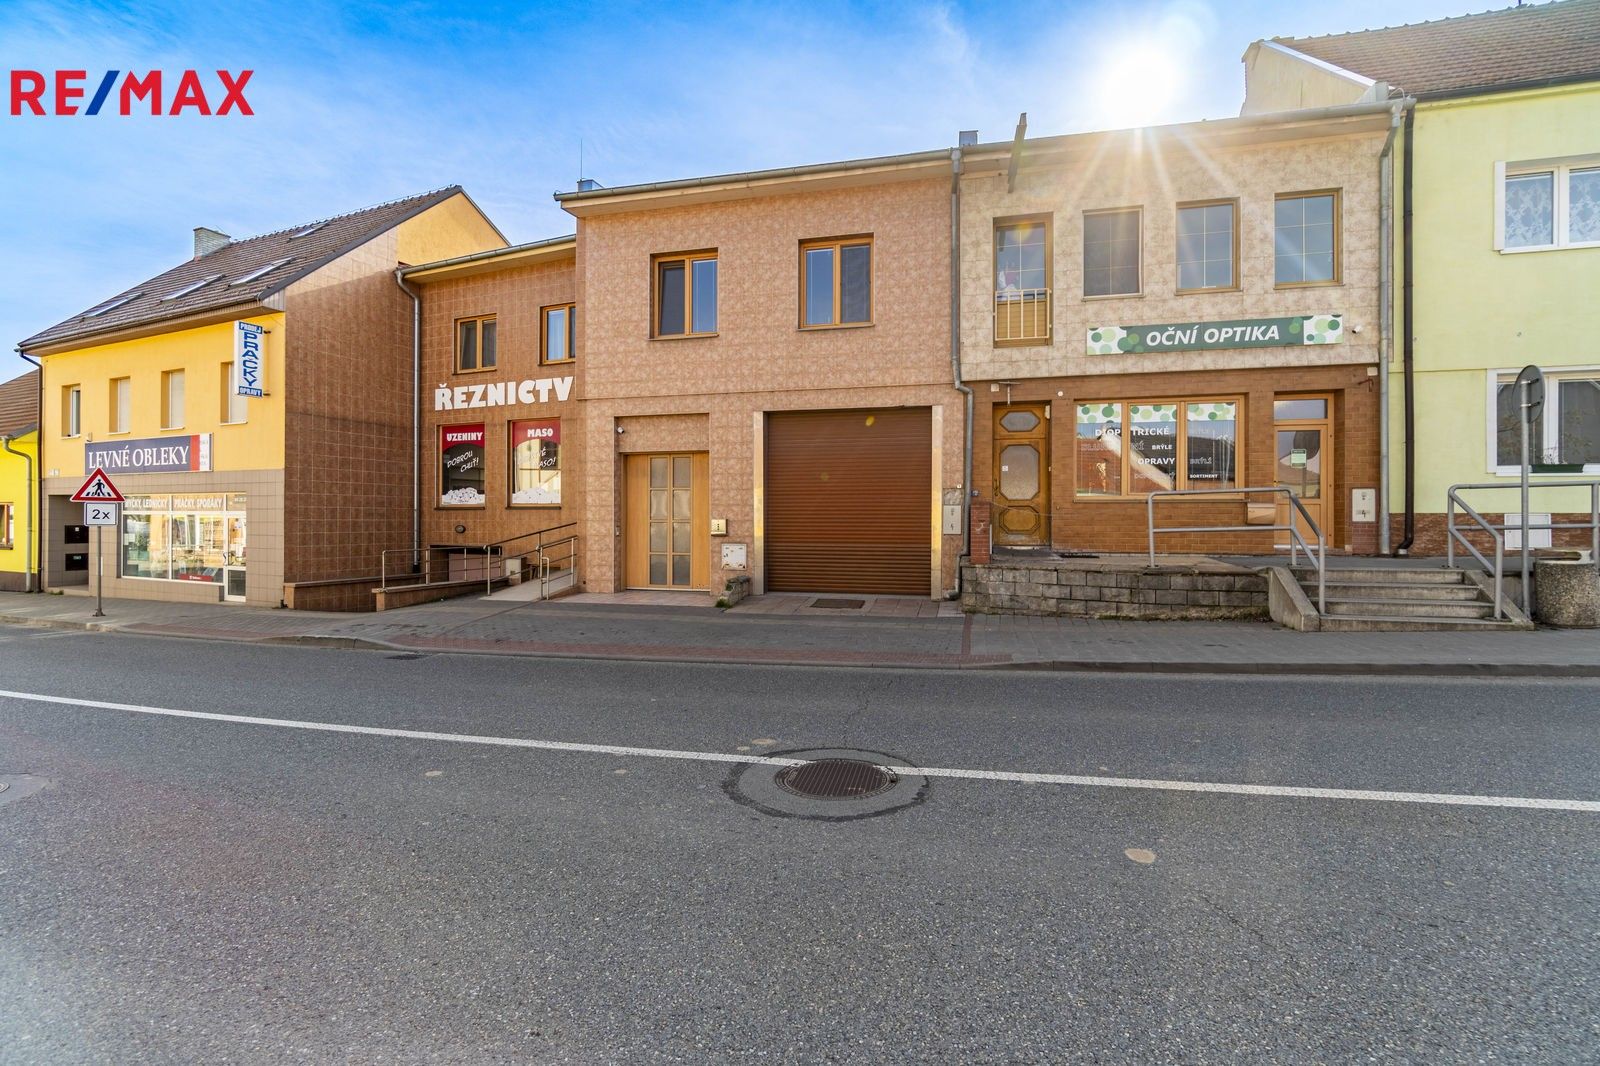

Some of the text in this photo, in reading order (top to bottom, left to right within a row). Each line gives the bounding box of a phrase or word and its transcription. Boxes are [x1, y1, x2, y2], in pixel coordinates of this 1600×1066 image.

[239, 322, 262, 334] PRODEJ
[1146, 325, 1279, 346] OČNÍ OPTIKA
[242, 331, 260, 387] PRAČKY
[447, 432, 483, 441] UZENINY
[527, 428, 553, 437] MASO
[89, 445, 130, 468] LEVNÉ
[133, 446, 189, 467] OBLEKY
[447, 450, 473, 468] DOBROU
[1138, 457, 1175, 465] OPRAVY
[92, 509, 110, 520] 2x
